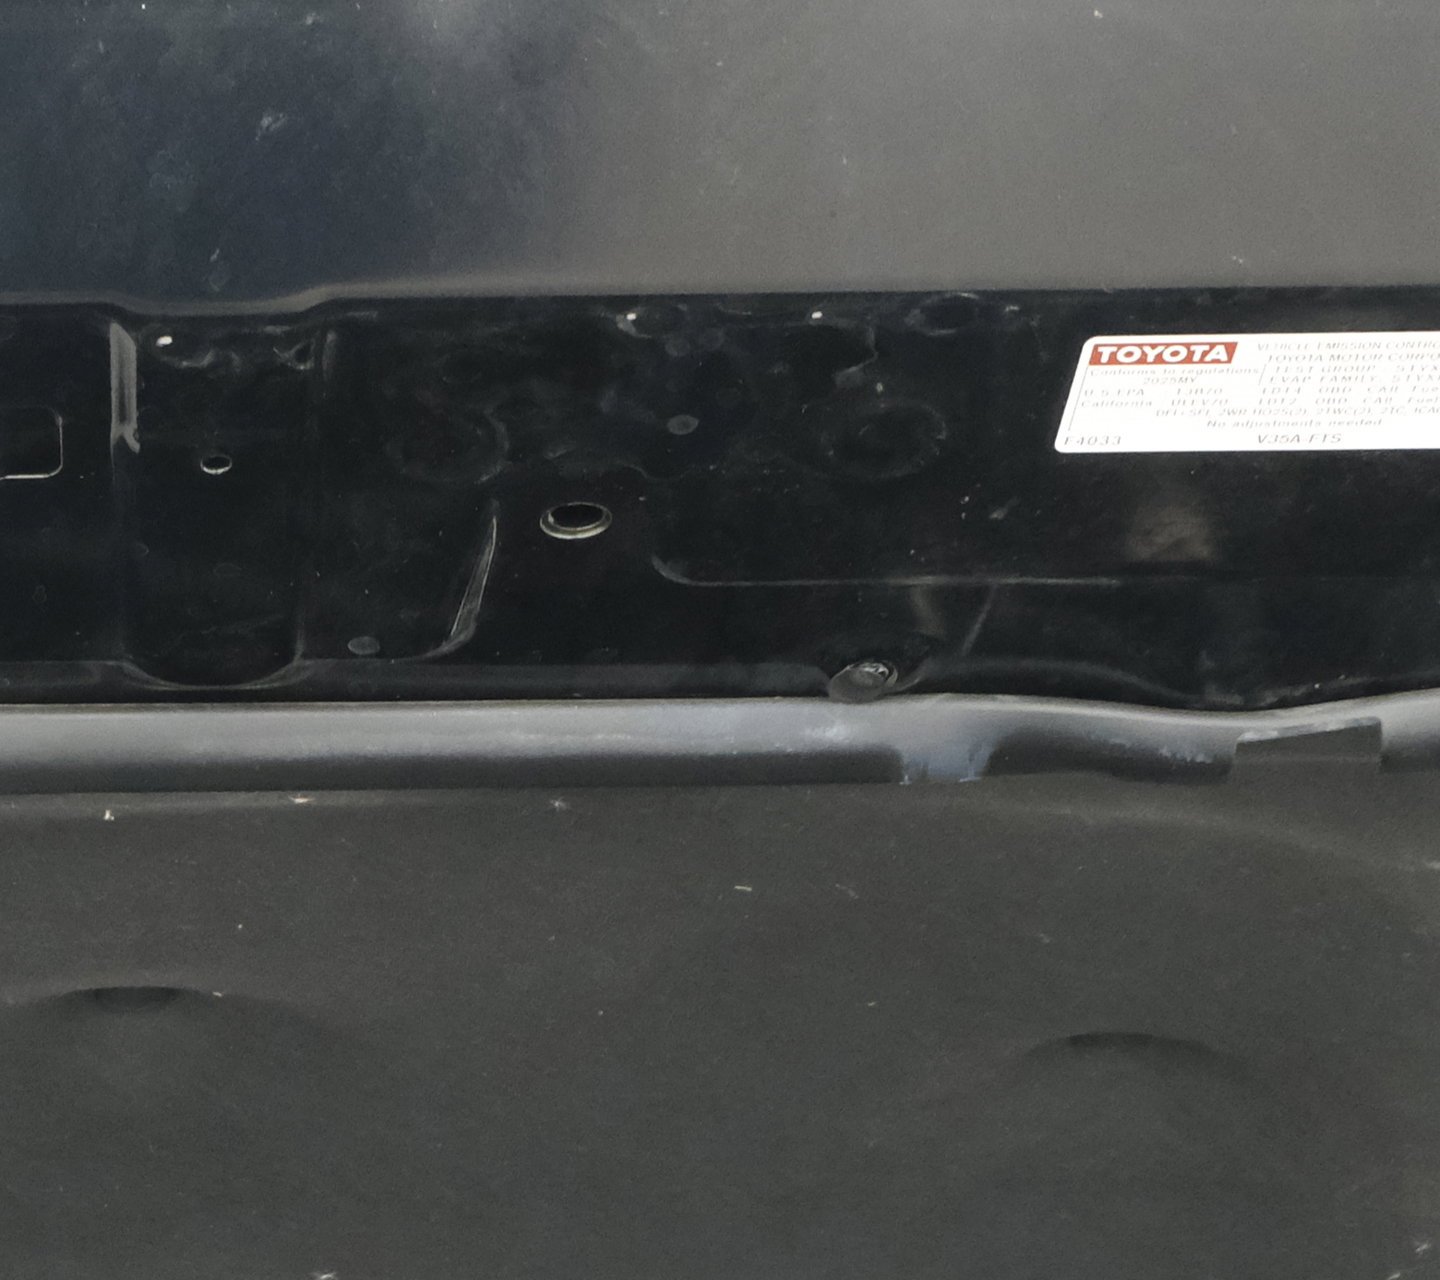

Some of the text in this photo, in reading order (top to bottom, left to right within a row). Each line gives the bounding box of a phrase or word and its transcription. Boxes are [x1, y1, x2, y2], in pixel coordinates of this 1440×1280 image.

[1256, 342, 1312, 350] VEHICLE
[1317, 341, 1382, 349] EMISSION
[1097, 344, 1229, 363] TOYOTA
[1266, 354, 1324, 362] TOYOTA
[1328, 353, 1383, 361] MOTOR
[1231, 419, 1323, 428] adjustments
